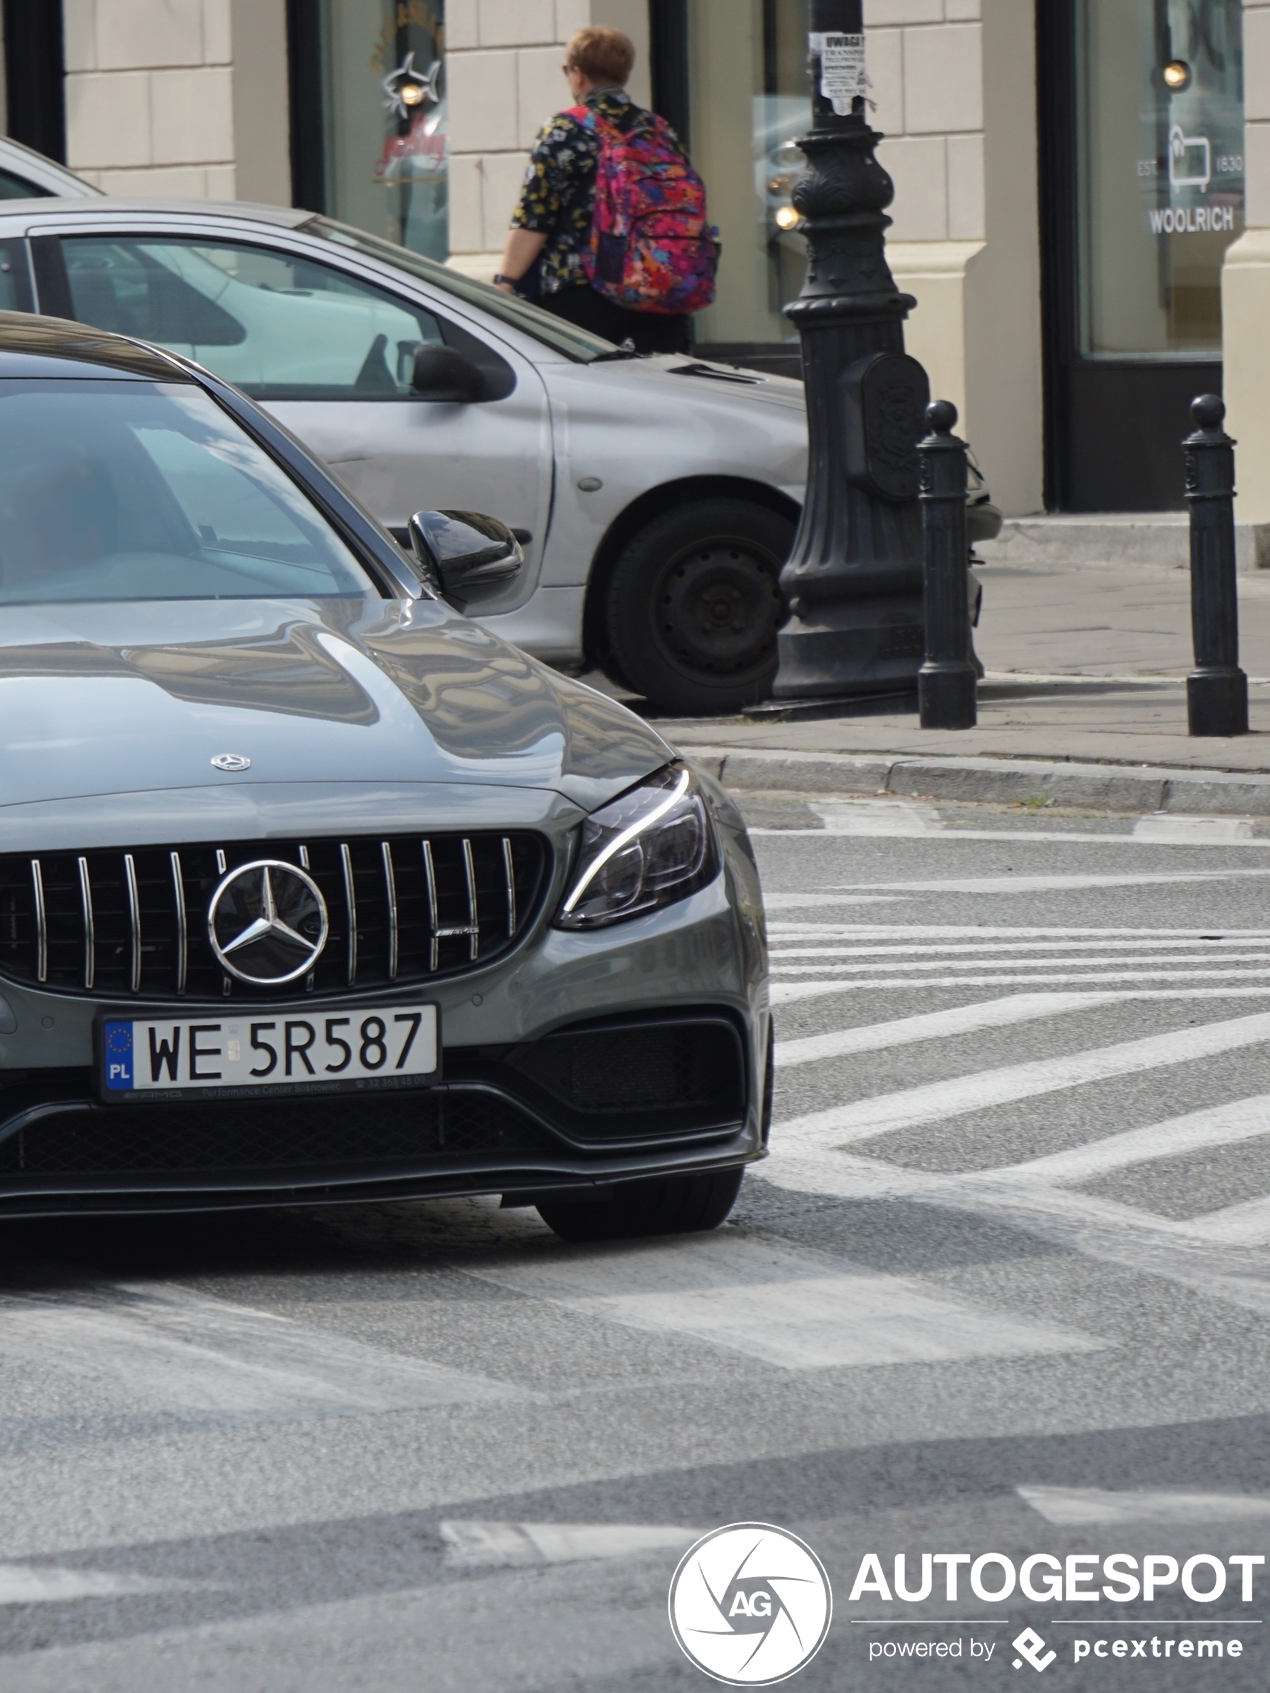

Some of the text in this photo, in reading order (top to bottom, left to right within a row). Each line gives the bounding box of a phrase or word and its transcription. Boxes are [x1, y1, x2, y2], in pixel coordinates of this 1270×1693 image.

[1216, 155, 1243, 172] 1830
[1149, 206, 1234, 234] WOOLRICH
[148, 1012, 422, 1082] WE 5R587
[110, 1064, 130, 1079] PL
[202, 1087, 260, 1098] Performance
[262, 1084, 292, 1095] Center
[294, 1082, 341, 1093] Sosnowiec
